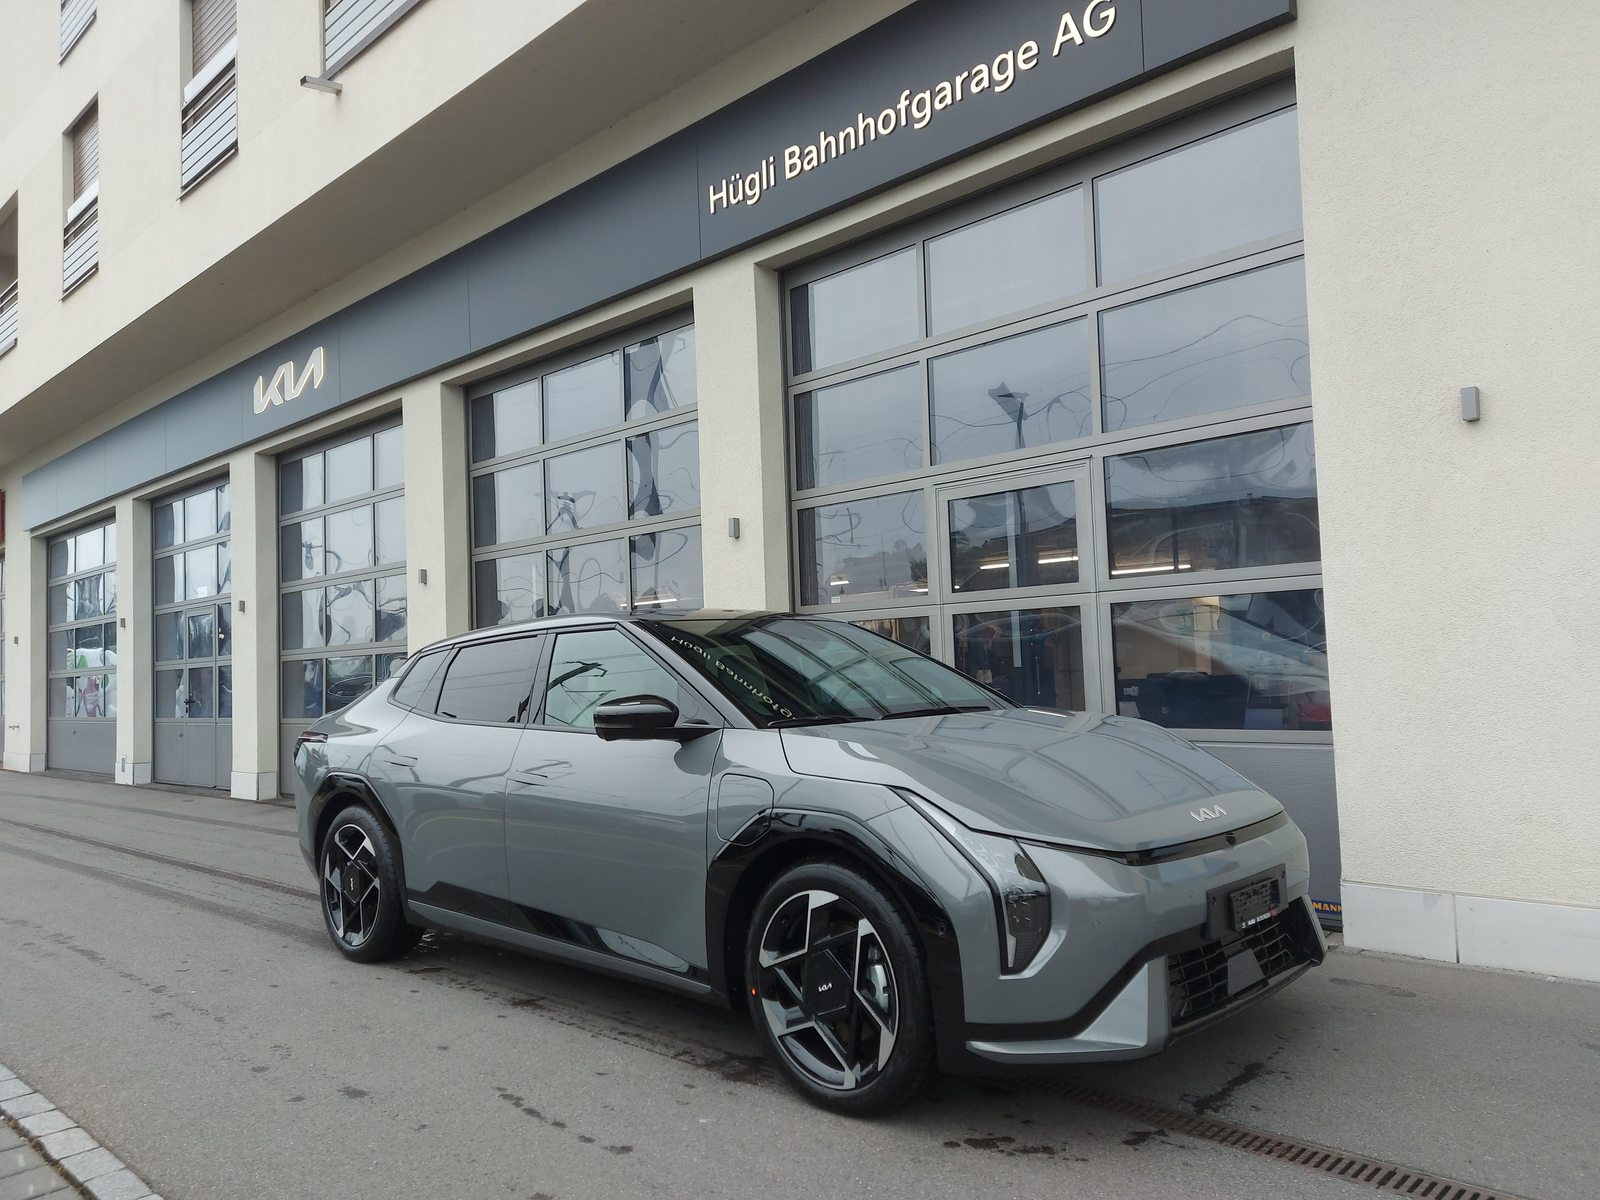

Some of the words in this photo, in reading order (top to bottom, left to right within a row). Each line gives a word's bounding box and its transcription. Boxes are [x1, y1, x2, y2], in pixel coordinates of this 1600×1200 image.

[709, 155, 777, 215] Hügli
[784, 40, 1040, 181] Bahnhofgarage
[1052, 0, 1116, 57] AG
[253, 345, 324, 415] KIA
